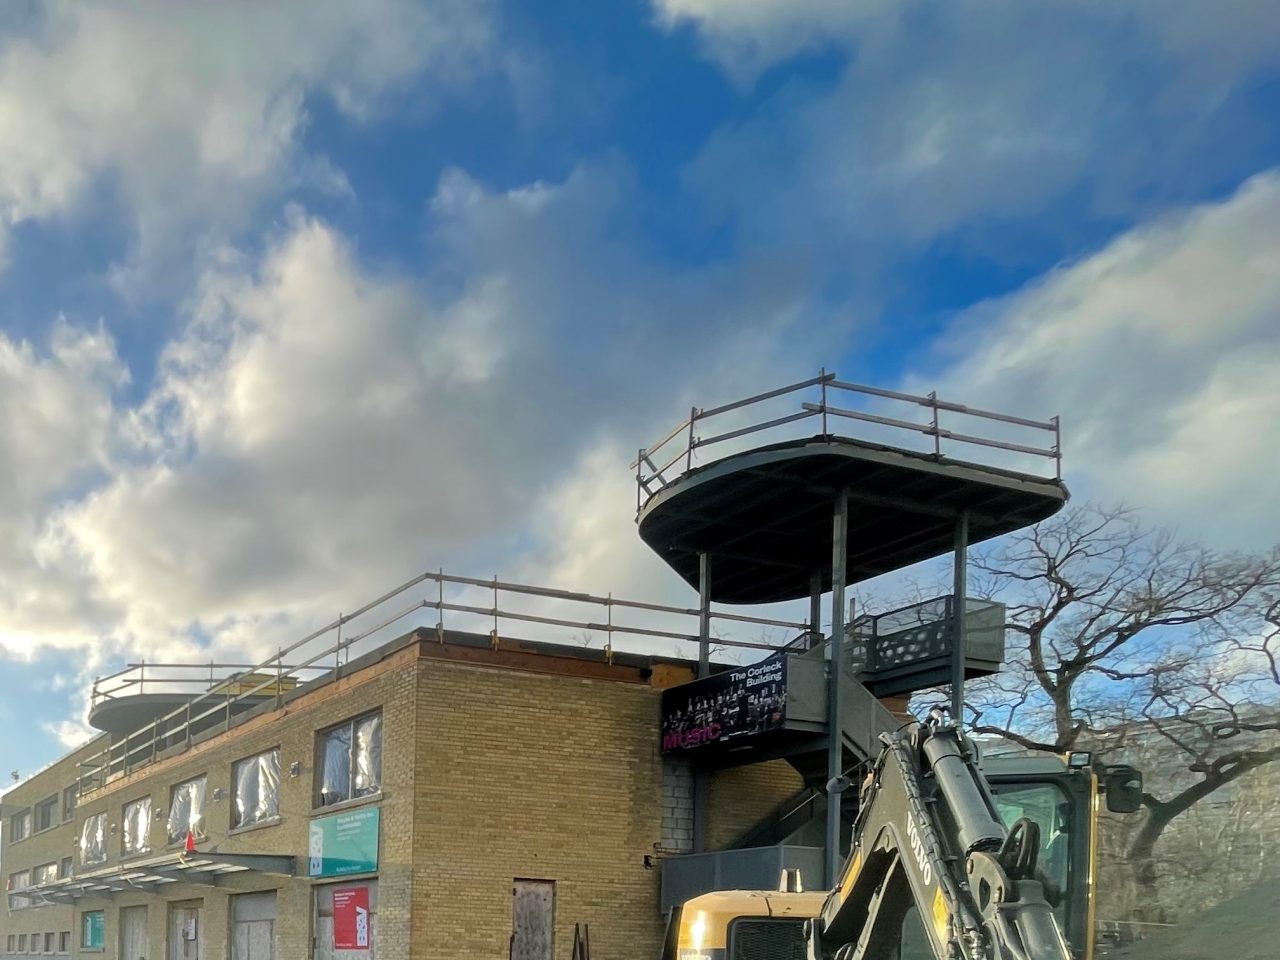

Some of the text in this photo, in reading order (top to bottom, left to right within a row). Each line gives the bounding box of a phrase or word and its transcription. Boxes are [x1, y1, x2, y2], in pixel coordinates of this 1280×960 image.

[730, 660, 782, 682] The Corleck
[746, 671, 782, 688] Building
[663, 723, 722, 750] MUSIC
[906, 810, 931, 886] VOLVO
